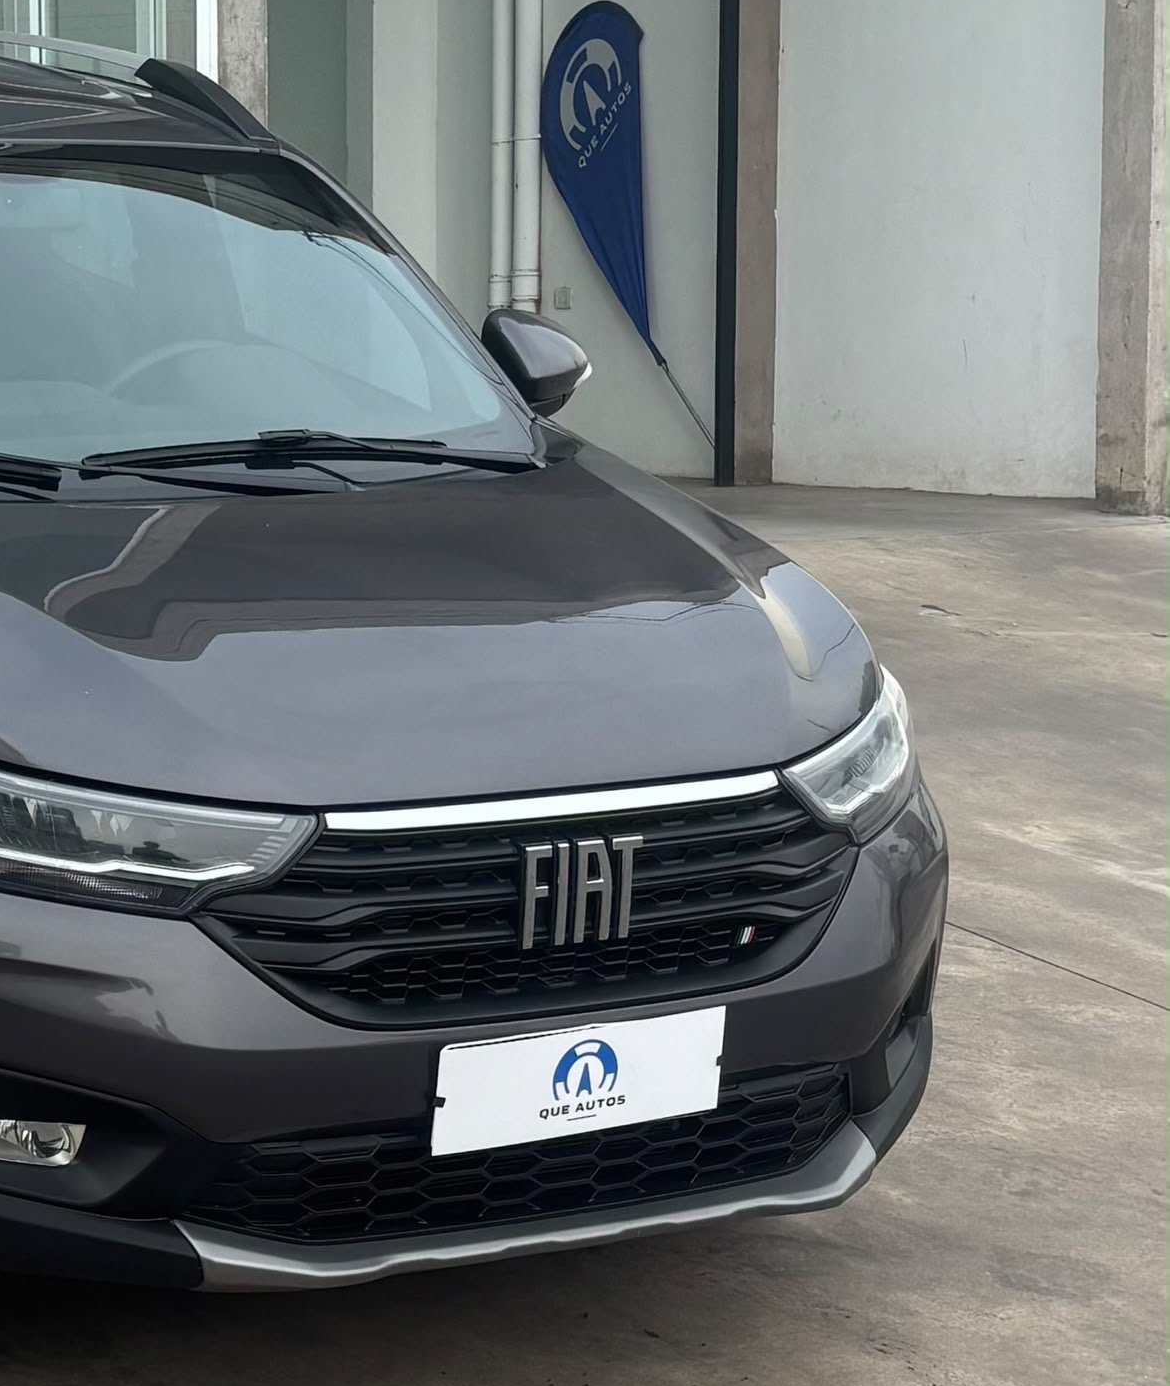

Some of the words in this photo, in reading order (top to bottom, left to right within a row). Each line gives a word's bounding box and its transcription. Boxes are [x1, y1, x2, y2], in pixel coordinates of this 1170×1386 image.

[578, 135, 599, 169] QUE
[599, 81, 632, 137] AUTOS
[521, 834, 644, 951] FIAT
[539, 1104, 571, 1121] QUE
[575, 1094, 626, 1113] AUTOS
